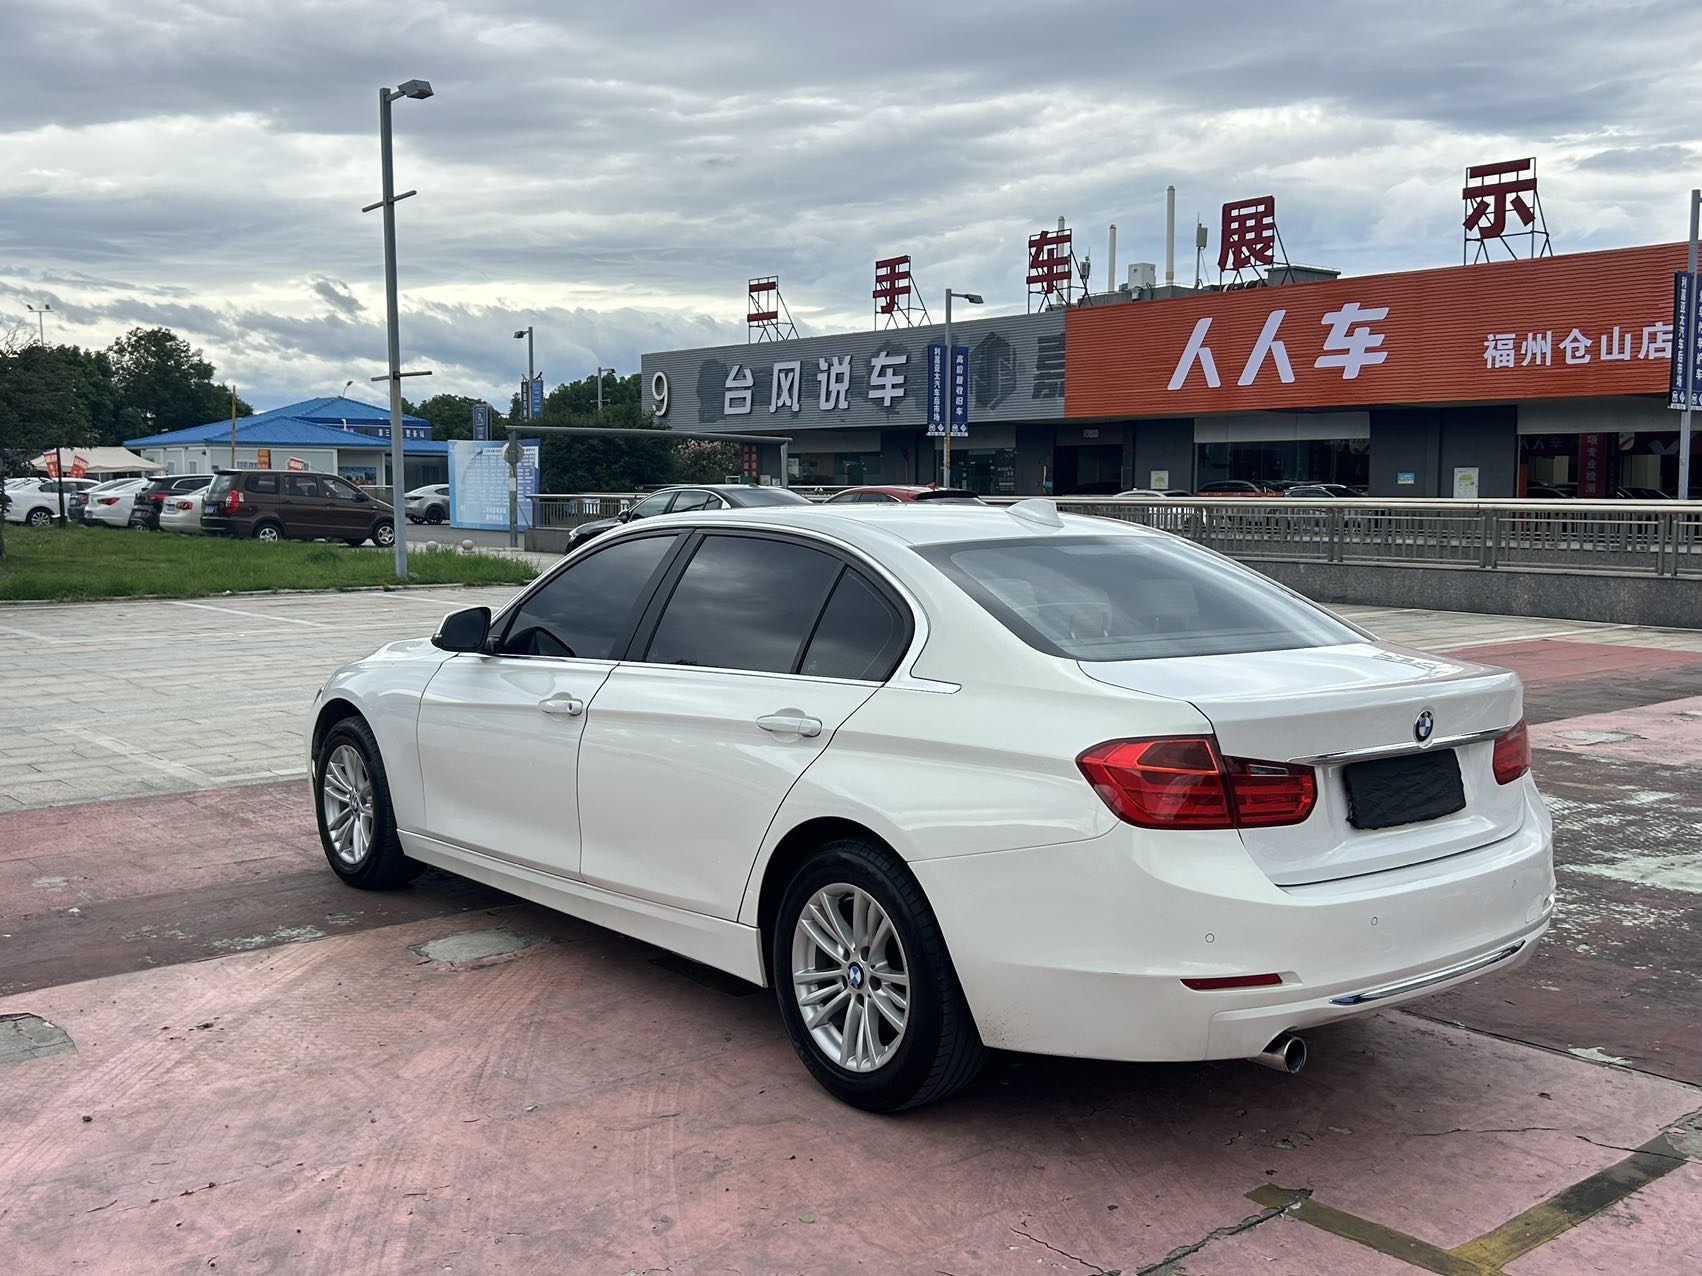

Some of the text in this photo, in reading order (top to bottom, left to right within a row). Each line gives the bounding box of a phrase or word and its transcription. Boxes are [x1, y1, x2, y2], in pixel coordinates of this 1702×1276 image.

[1166, 302, 1390, 391] 人人车
[1483, 321, 1673, 370] 福州仓山店
[650, 371, 672, 418] 9
[723, 350, 909, 416] 台风说车
